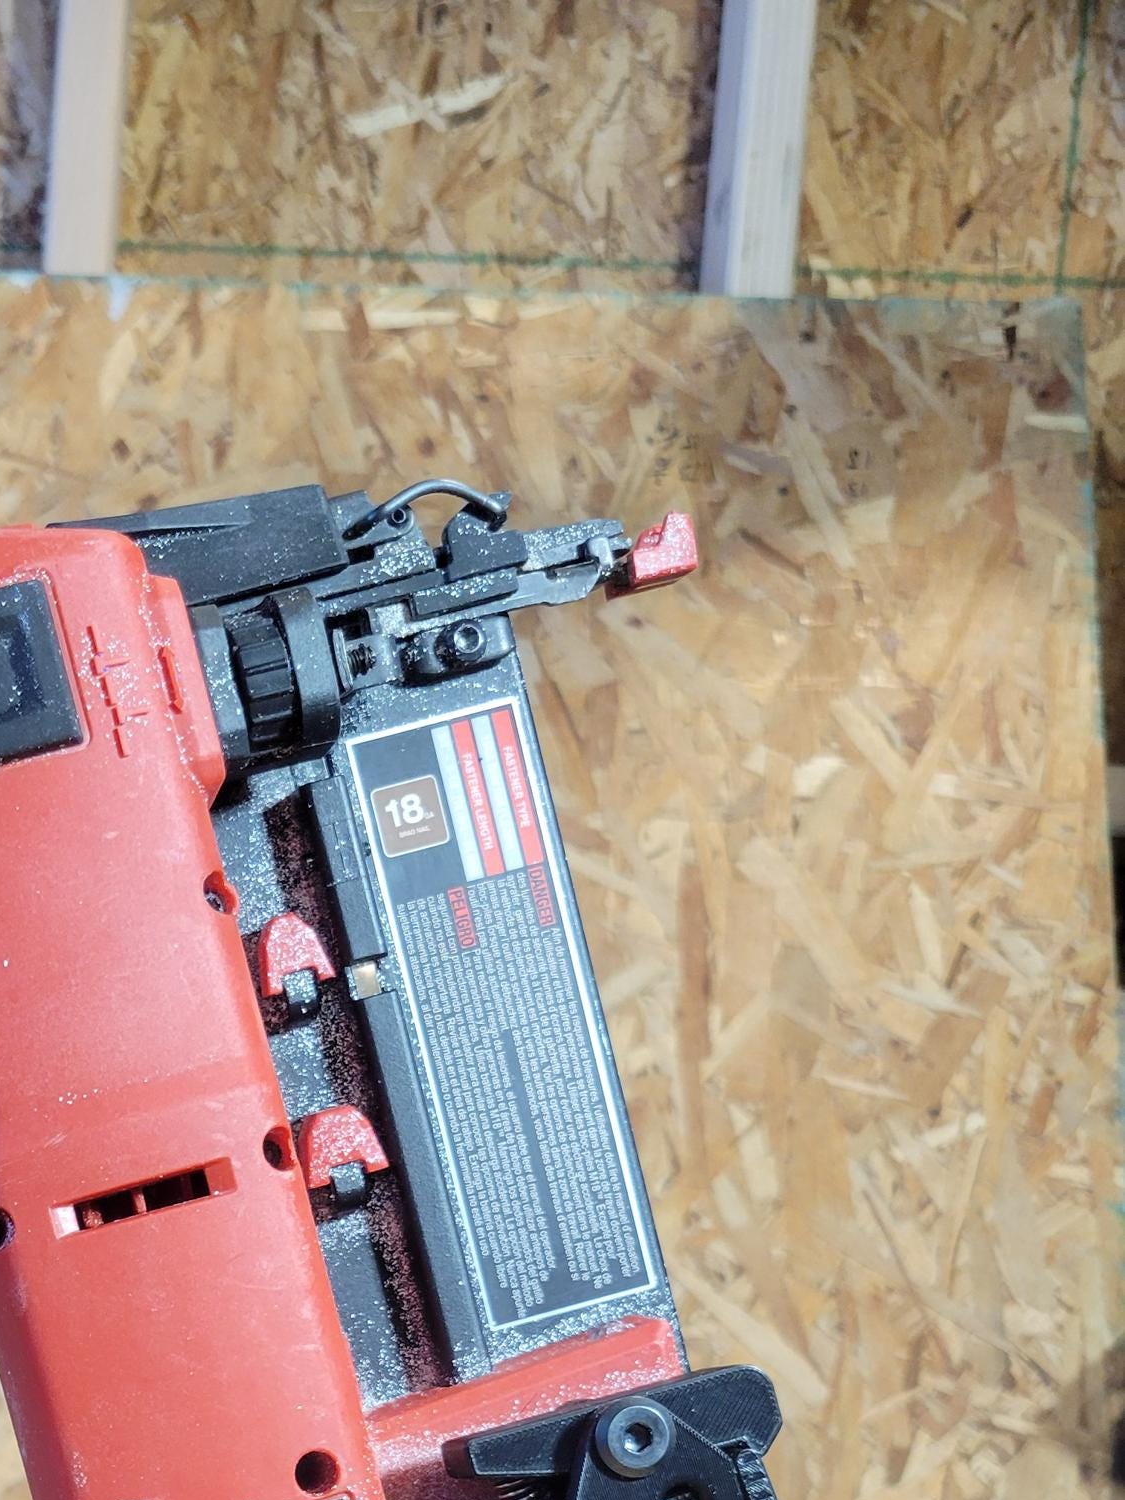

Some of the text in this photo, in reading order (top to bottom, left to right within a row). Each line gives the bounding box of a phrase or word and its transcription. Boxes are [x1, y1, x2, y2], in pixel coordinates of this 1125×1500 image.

[385, 793, 424, 828] 18
[461, 753, 493, 850] FASTENER LENGTH
[502, 745, 531, 828] FASTENER TYPE
[448, 889, 474, 947] PELIGRO
[528, 868, 553, 925] DANGER
